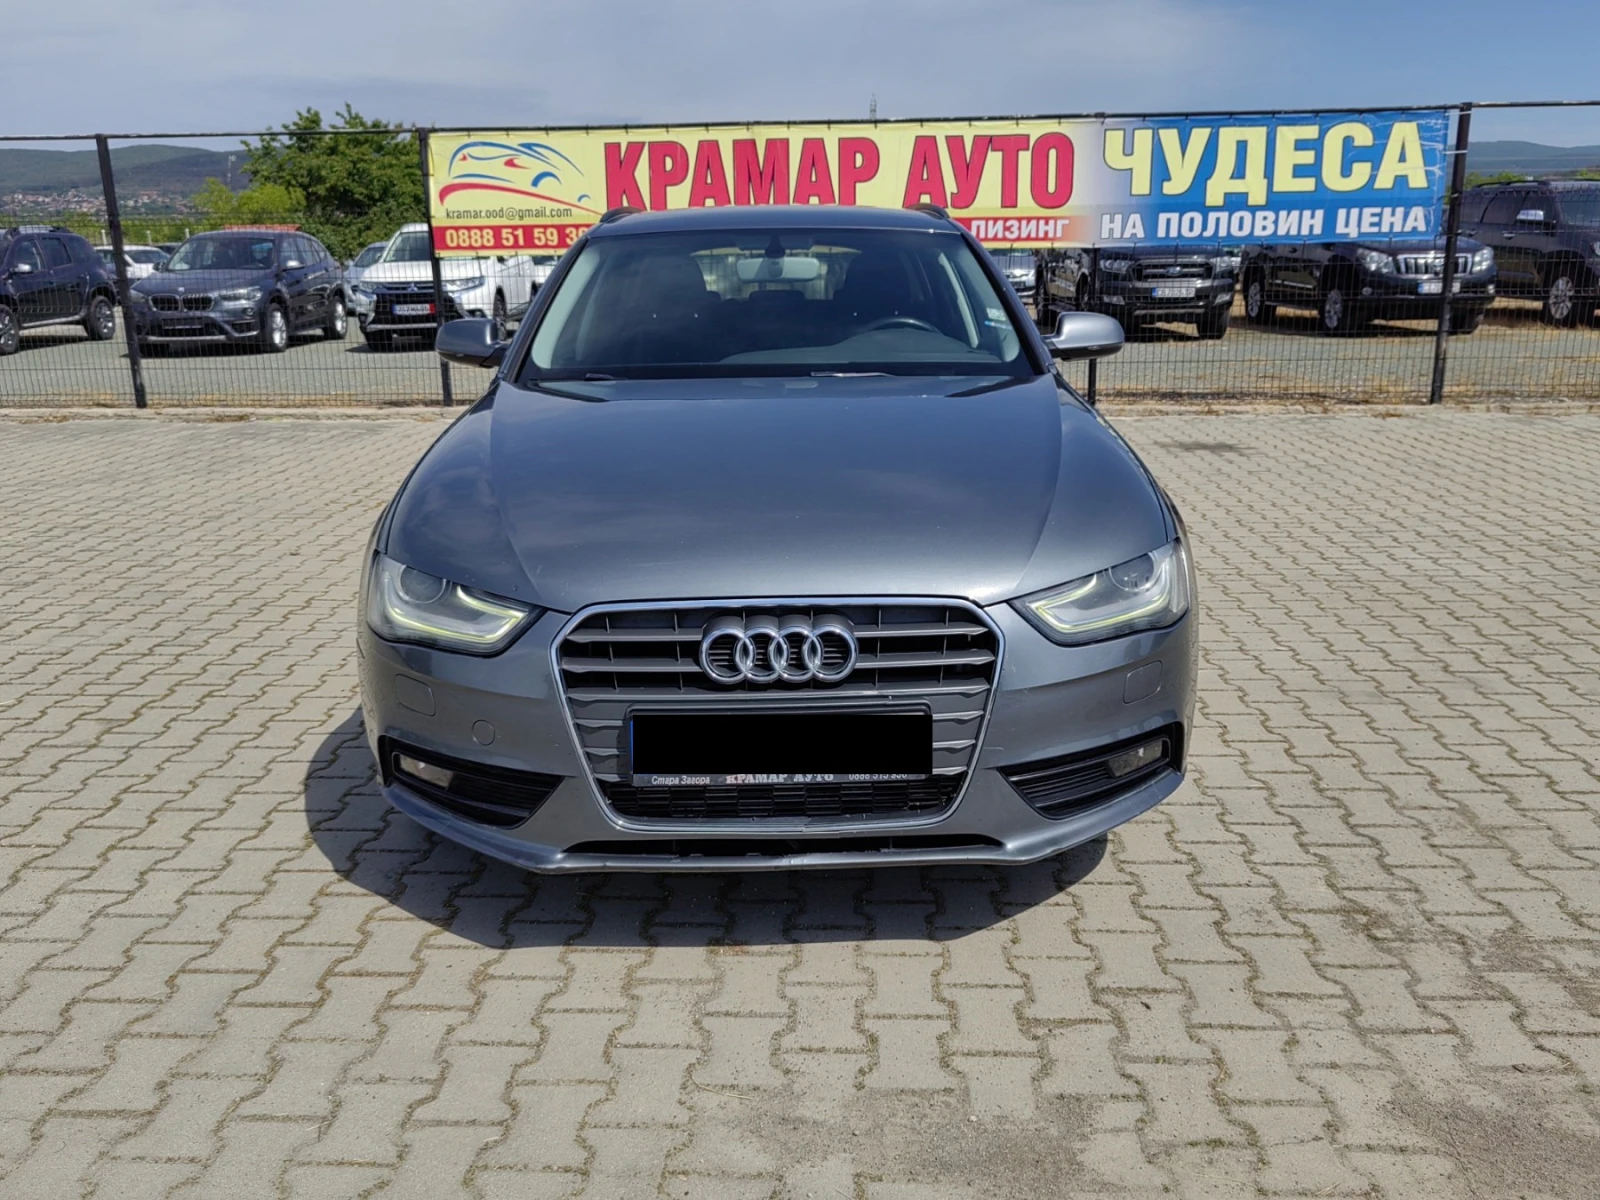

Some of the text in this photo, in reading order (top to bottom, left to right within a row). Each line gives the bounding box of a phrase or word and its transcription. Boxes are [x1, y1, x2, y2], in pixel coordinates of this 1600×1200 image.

[604, 132, 1075, 212] КРАМАР АУТО
[1103, 121, 1429, 207] ЧУДЕСА
[446, 206, 573, 221] kramar.ood@gmail.com
[1101, 206, 1428, 239] НА ПОЛОВИН ЦЕНА
[445, 228, 496, 248] 0888
[501, 228, 525, 247] 51
[533, 227, 559, 246] 59
[970, 219, 1070, 239] ЛИЗИНГ
[651, 773, 835, 786] Стара Загора КРАМАР АУТО
